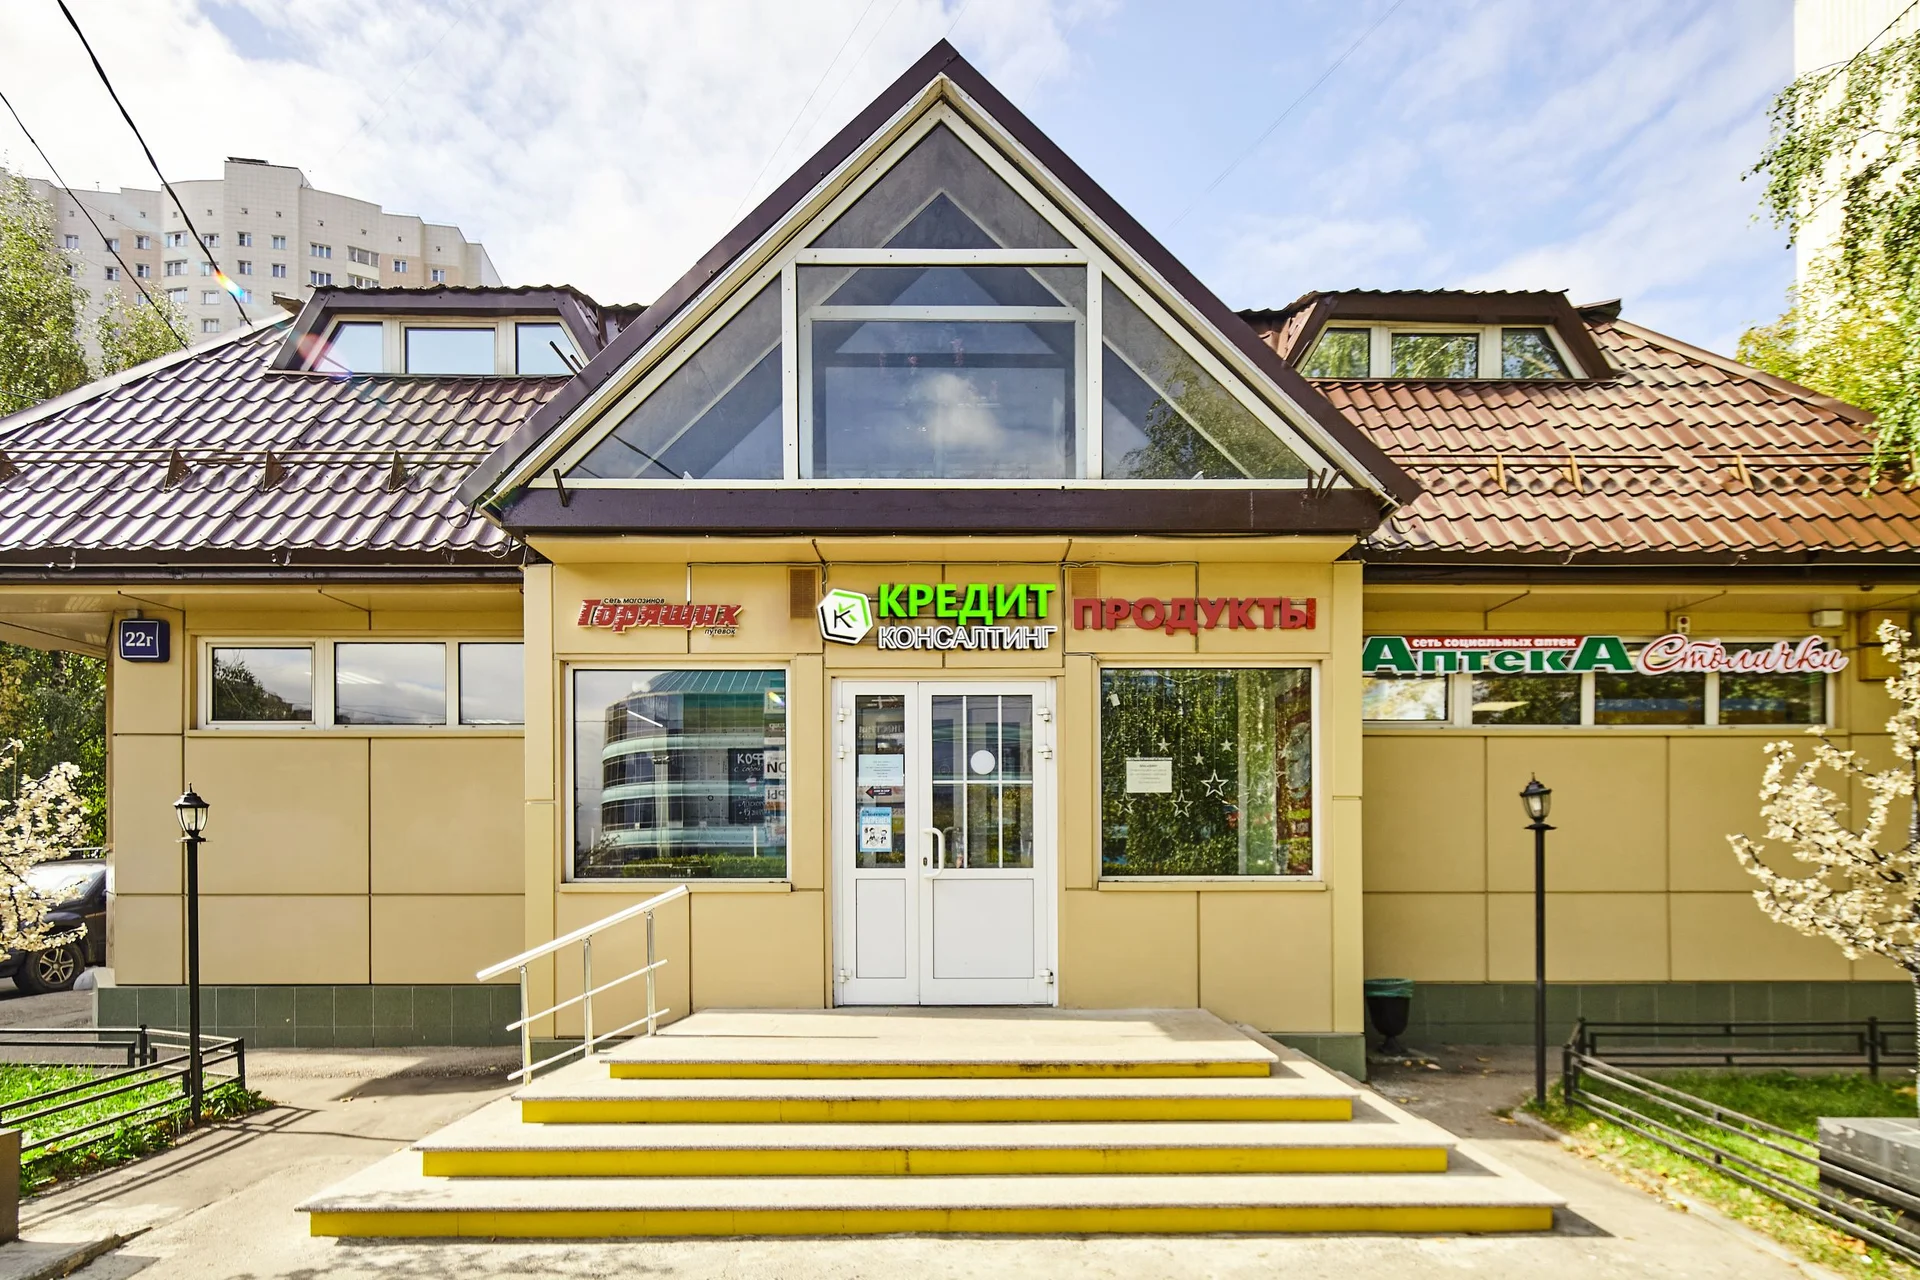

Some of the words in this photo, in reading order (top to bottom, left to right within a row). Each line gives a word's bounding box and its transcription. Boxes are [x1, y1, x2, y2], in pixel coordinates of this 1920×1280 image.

[604, 597, 622, 605] сеть
[878, 583, 1056, 626] КРЕДИТ
[1073, 597, 1317, 636] ПРОДУКТЫ
[125, 631, 154, 647] 22г
[704, 627, 736, 637] путевок
[877, 626, 1058, 650] КОНСАЛТИНГ
[1412, 638, 1441, 648] сеть
[1444, 638, 1532, 649] социальных
[1536, 638, 1576, 648] аптек
[1639, 634, 1848, 674] Столички
[737, 753, 766, 766] КОФ
